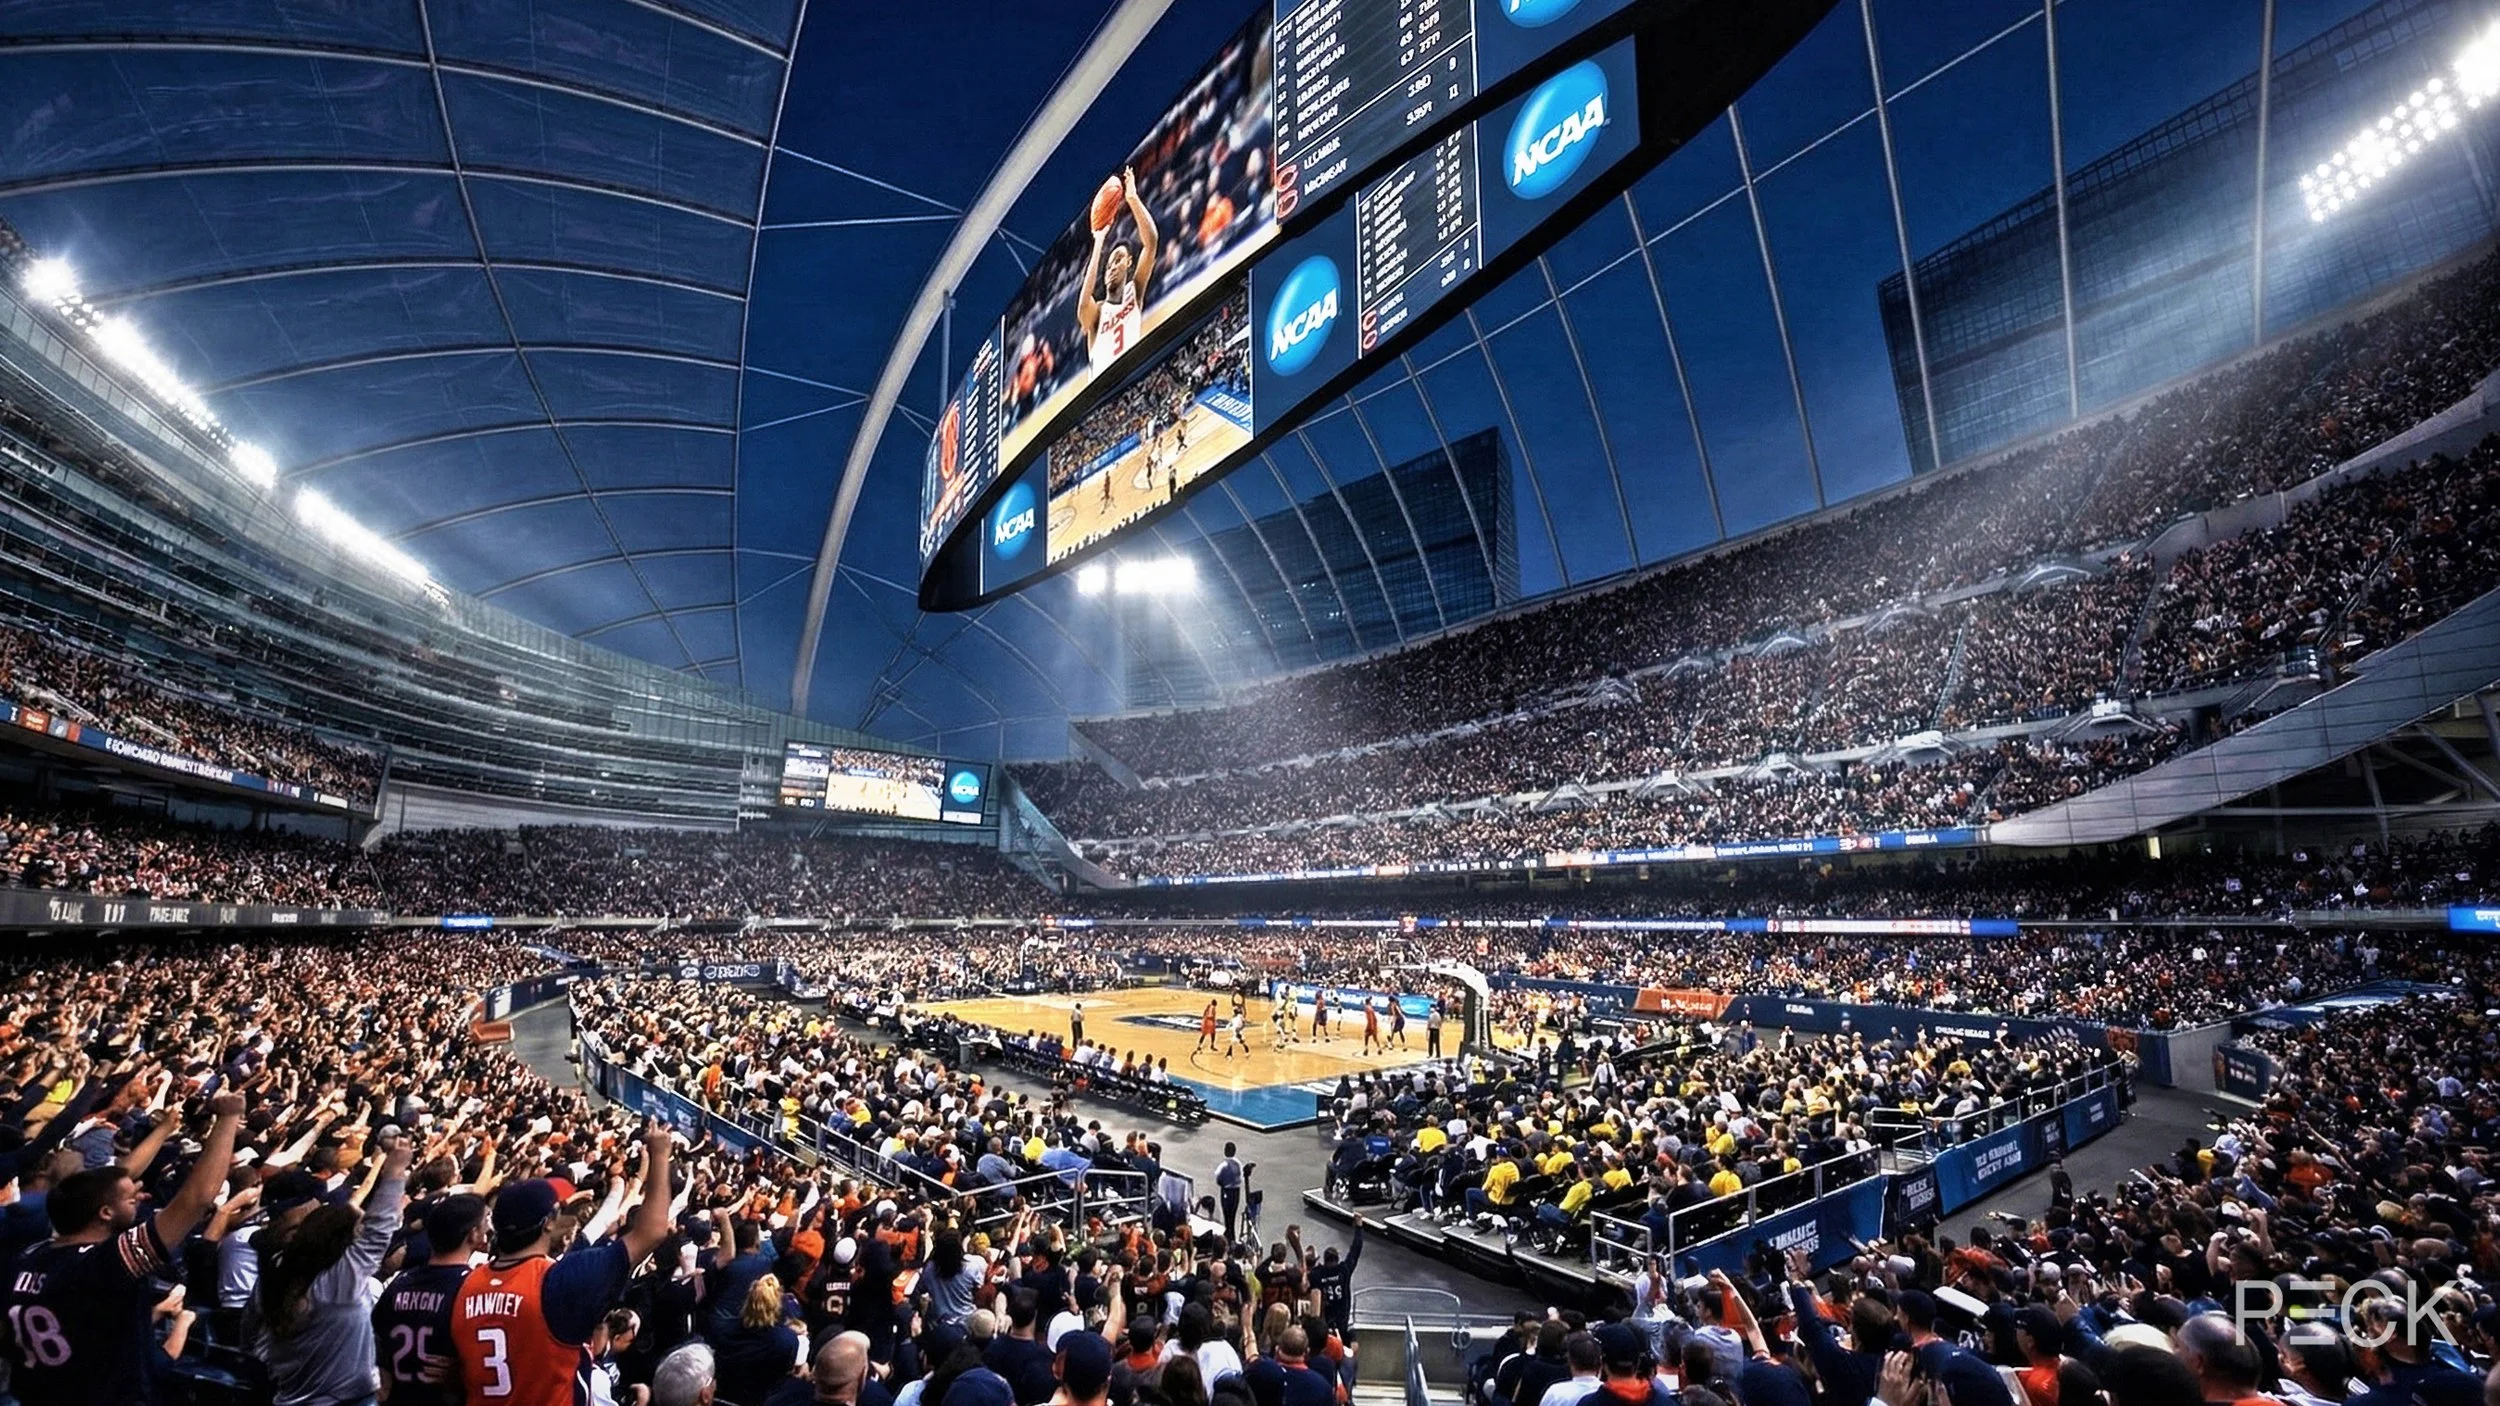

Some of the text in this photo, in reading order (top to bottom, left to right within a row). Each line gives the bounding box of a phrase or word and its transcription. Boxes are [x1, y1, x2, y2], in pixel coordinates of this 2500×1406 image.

[1513, 92, 1605, 187] NCAA
[1113, 323, 1124, 356] 3
[1270, 287, 1338, 361] NCAA
[993, 508, 1035, 546] NCAA
[8, 1304, 72, 1369] 18
[389, 1324, 440, 1383] 25
[477, 1328, 512, 1396] 3
